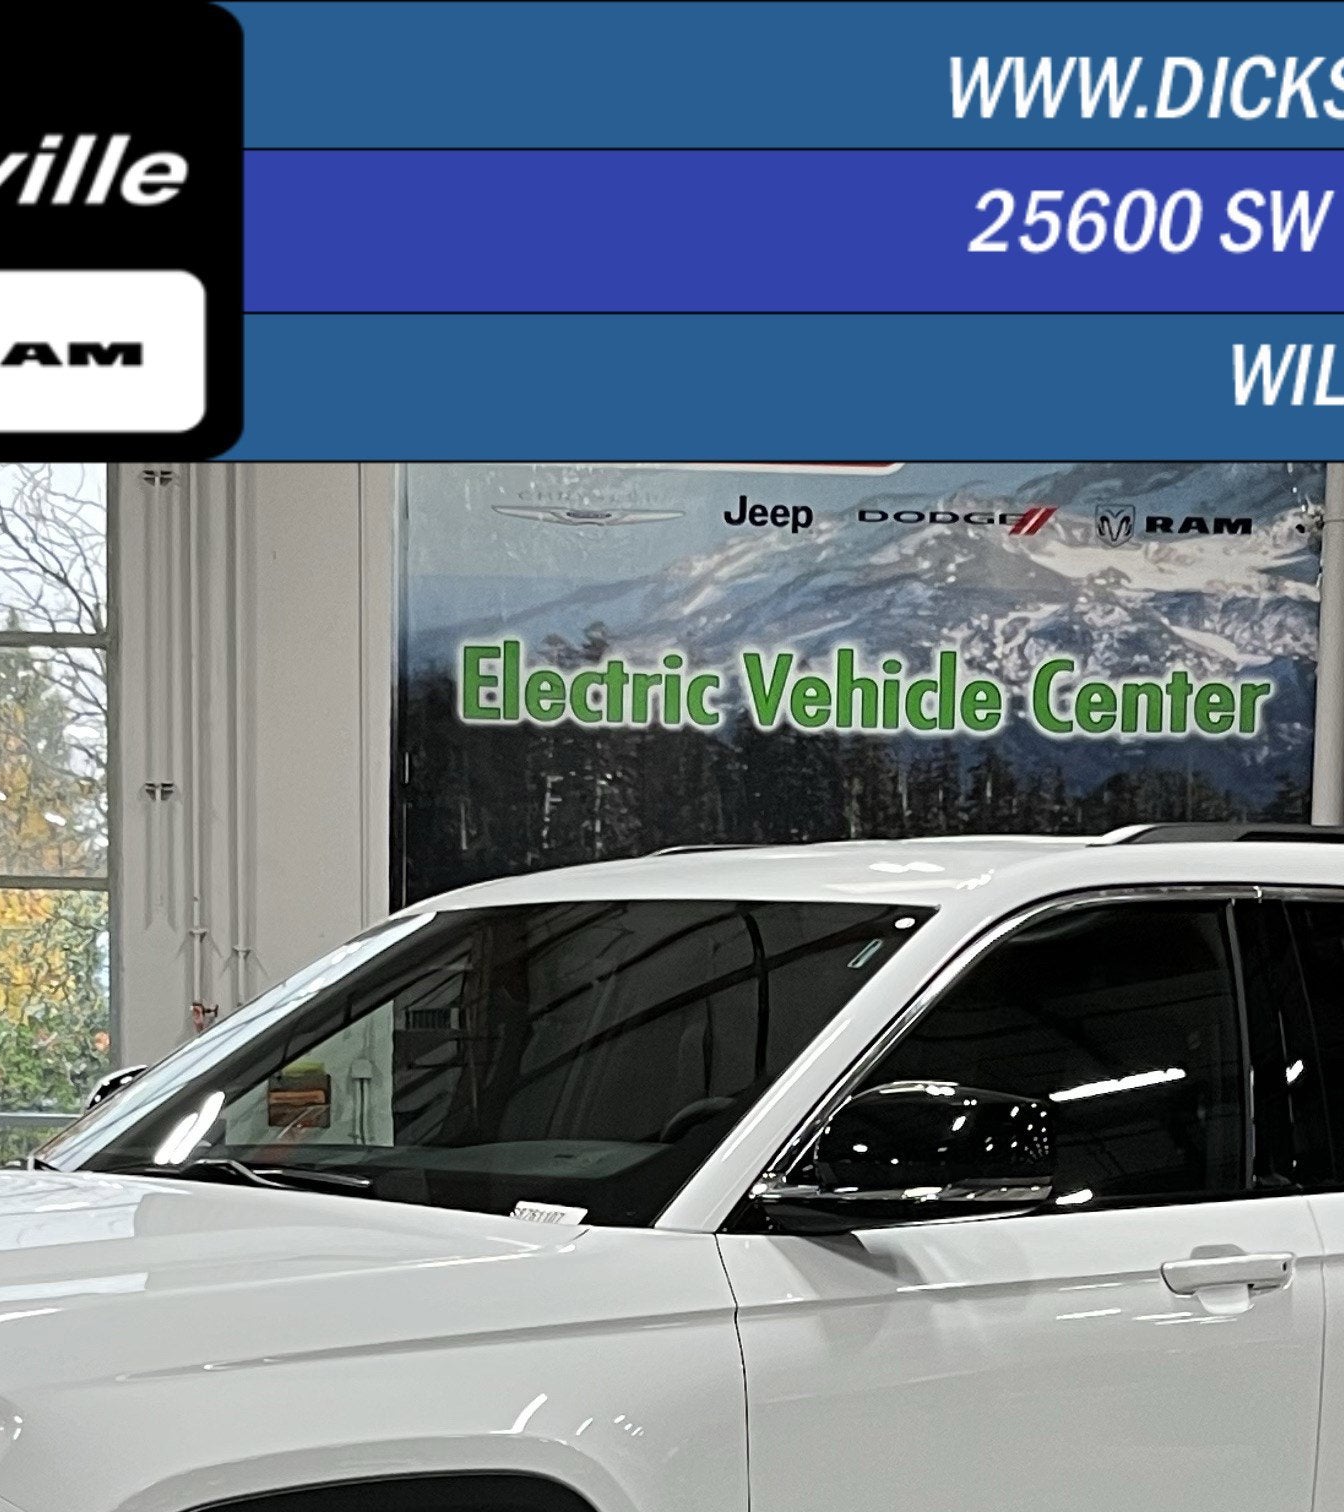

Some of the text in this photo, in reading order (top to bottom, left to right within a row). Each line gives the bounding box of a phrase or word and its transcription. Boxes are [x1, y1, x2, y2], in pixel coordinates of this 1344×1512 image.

[723, 495, 814, 533] Jeep
[857, 509, 1026, 526] DODGE
[1145, 515, 1253, 536] RAM
[462, 640, 1273, 734] Electric Vehicle Center
